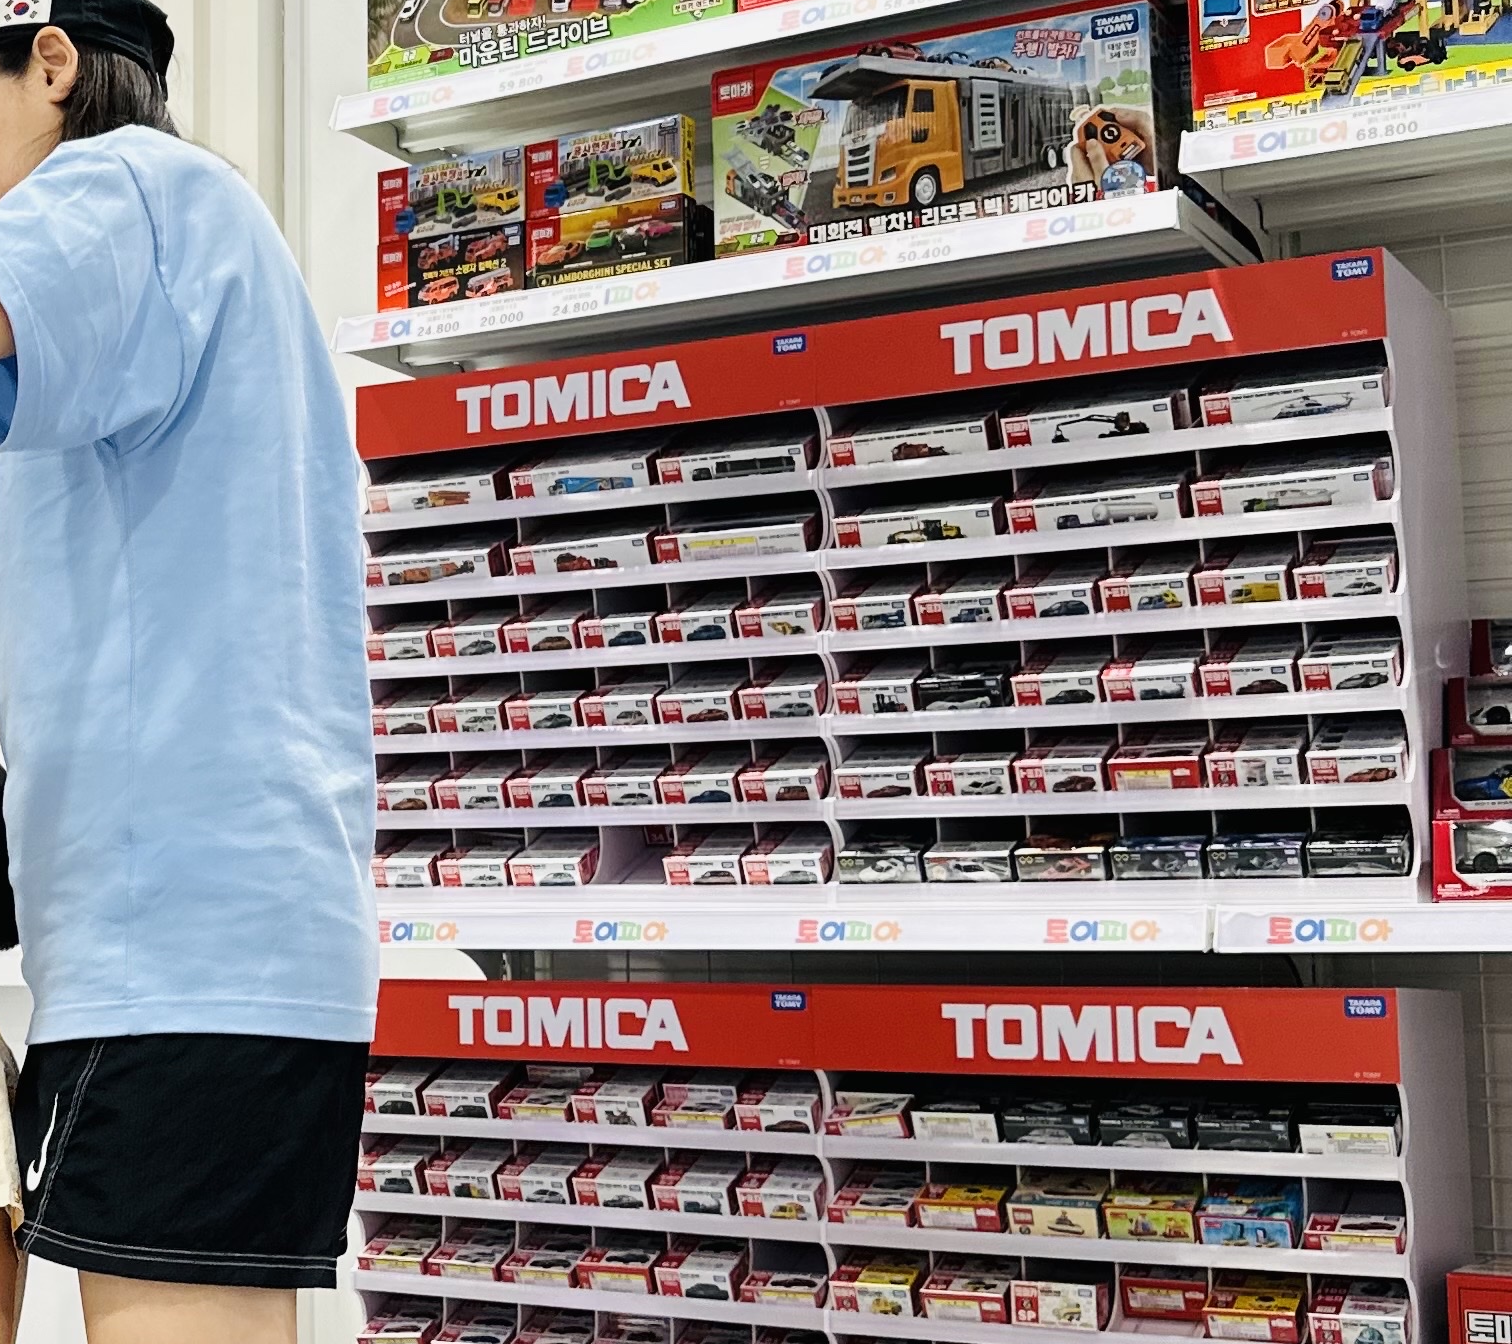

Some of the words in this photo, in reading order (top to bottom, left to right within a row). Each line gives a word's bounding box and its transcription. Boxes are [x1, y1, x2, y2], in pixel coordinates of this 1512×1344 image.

[1095, 14, 1135, 26] TAKARA
[1095, 22, 1135, 36] TOMY
[459, 39, 519, 68] 마운틴
[525, 16, 612, 53] 드라이브
[498, 74, 543, 92] 59.800
[719, 80, 754, 102] 토미카
[1231, 121, 1348, 160] 토이피아
[1356, 122, 1418, 141] 68.800
[809, 218, 863, 244] 대회전
[869, 209, 913, 236] 발차!
[1009, 186, 1068, 212] 캐리어
[1074, 182, 1095, 202] 카
[1024, 207, 1136, 242] 토이피아
[783, 245, 886, 279] 토이피아
[897, 246, 951, 264] 50.400
[1334, 258, 1370, 271] TAKARA
[552, 264, 614, 285] LAMBORGHINI
[616, 260, 650, 279] SPECIAL
[651, 257, 672, 271] SET
[1335, 266, 1370, 278] TOMY
[552, 299, 598, 316] 24.800
[417, 321, 460, 337] 24.800
[480, 312, 524, 328] 20.000
[939, 288, 1234, 375] TOMICA
[776, 341, 804, 352] TOMY
[455, 360, 691, 434] TOMICA
[573, 919, 669, 944] 토이피아
[795, 918, 902, 944] 토이피아
[1044, 918, 1161, 944] 토이피아
[1267, 917, 1393, 945] 토이피아
[774, 998, 803, 1009] TOMY
[1346, 998, 1385, 1009] TAKARA
[1347, 1003, 1383, 1016] TOMY
[448, 994, 688, 1051] TOMICA
[941, 1003, 1243, 1066] TOMICA
[1018, 1310, 1037, 1321] SP
